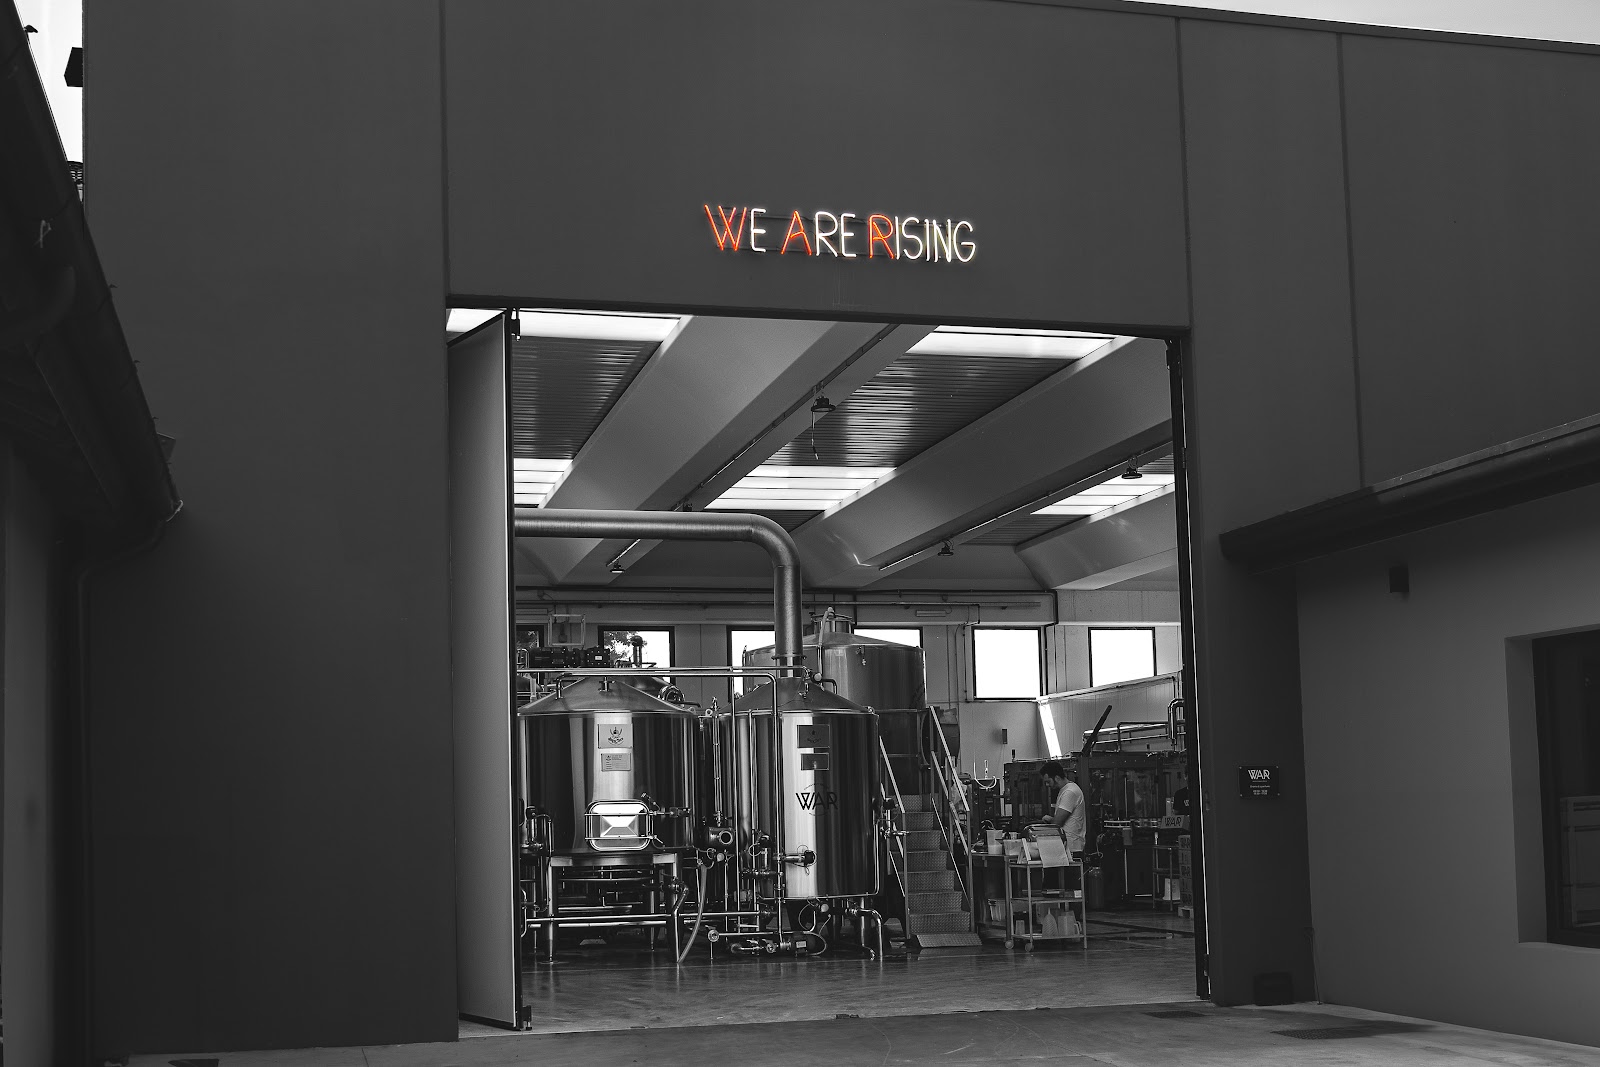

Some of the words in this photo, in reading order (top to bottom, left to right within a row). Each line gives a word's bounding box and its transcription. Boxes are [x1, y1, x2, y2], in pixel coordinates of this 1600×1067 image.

[704, 204, 767, 252] WE
[780, 210, 858, 258] ARE
[868, 213, 977, 263] RISING
[1247, 769, 1271, 780] WAR
[796, 791, 839, 811] WAR
